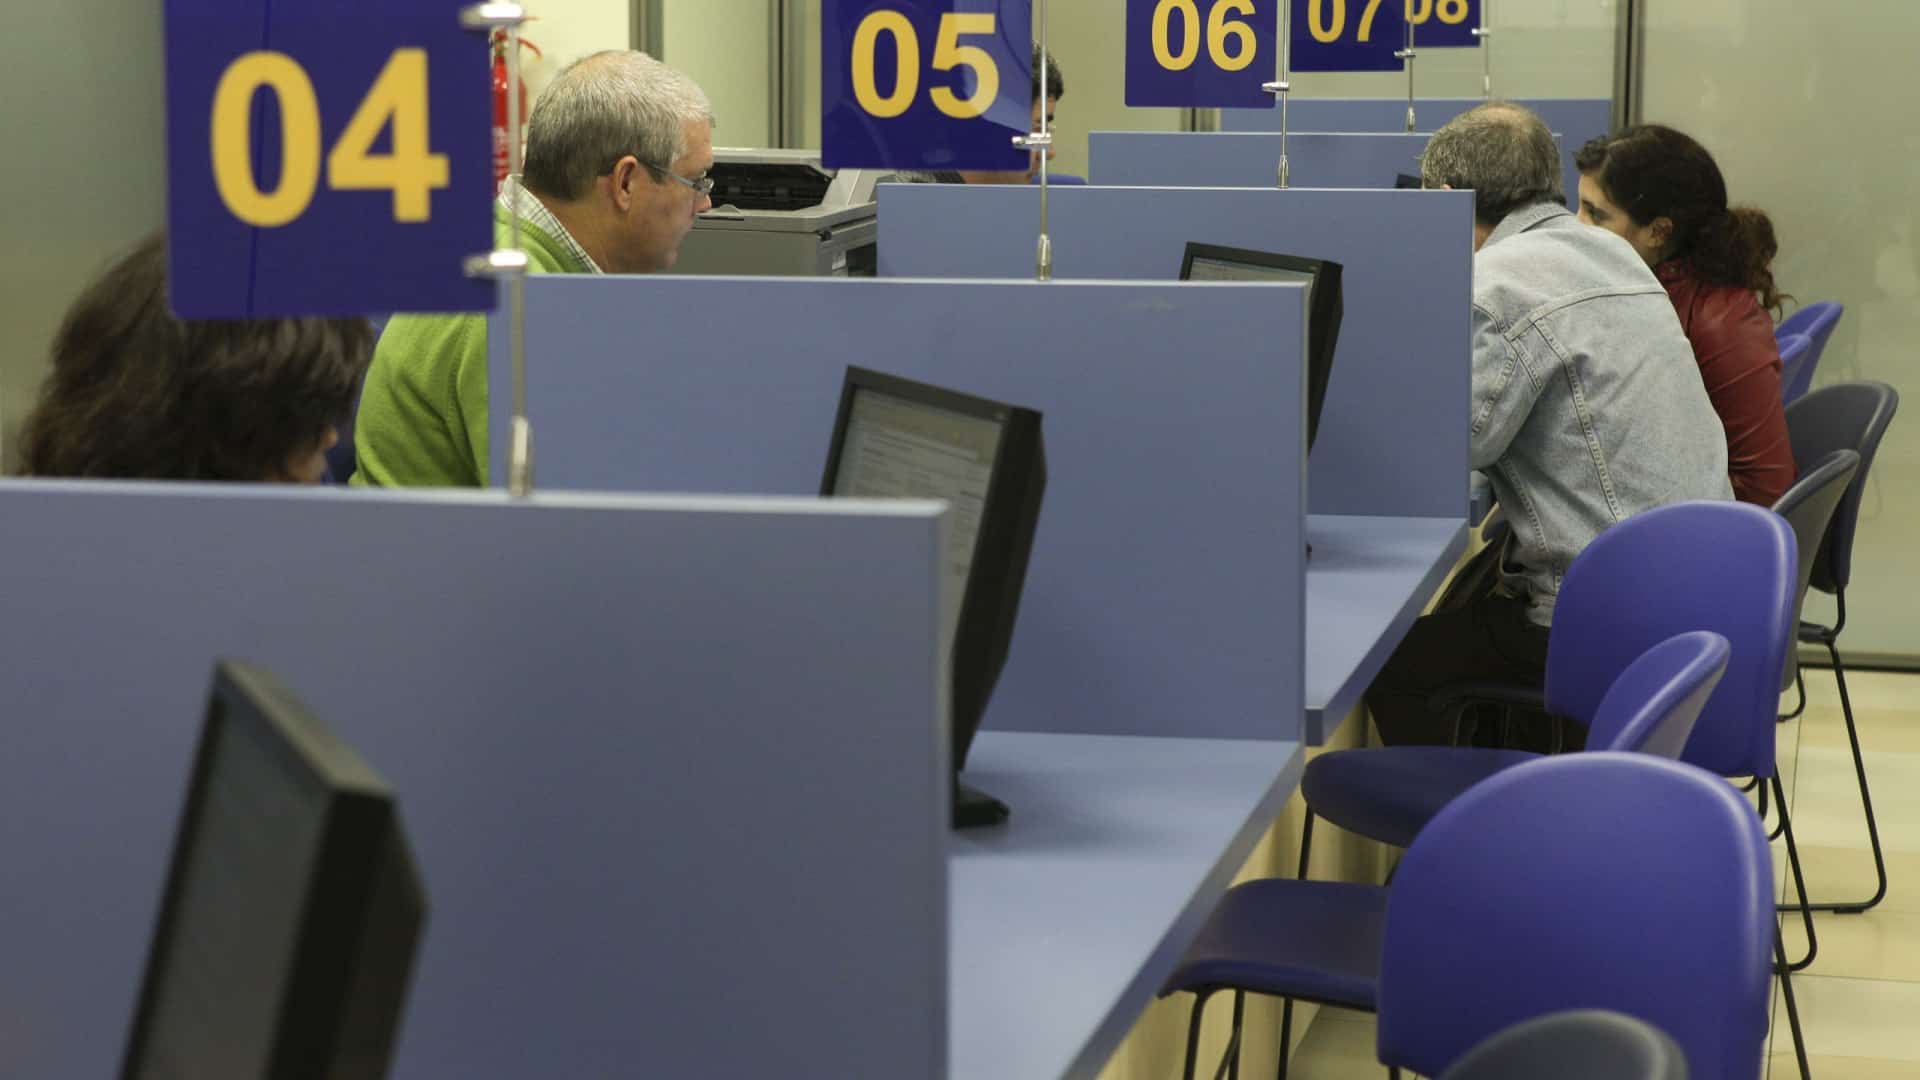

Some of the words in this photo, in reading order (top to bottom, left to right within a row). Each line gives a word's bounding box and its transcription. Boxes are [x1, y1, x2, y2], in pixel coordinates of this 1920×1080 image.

[851, 9, 1000, 119] 05
[1151, 0, 1257, 71] 06
[1308, 0, 1381, 43] 07
[211, 48, 450, 227] 04
